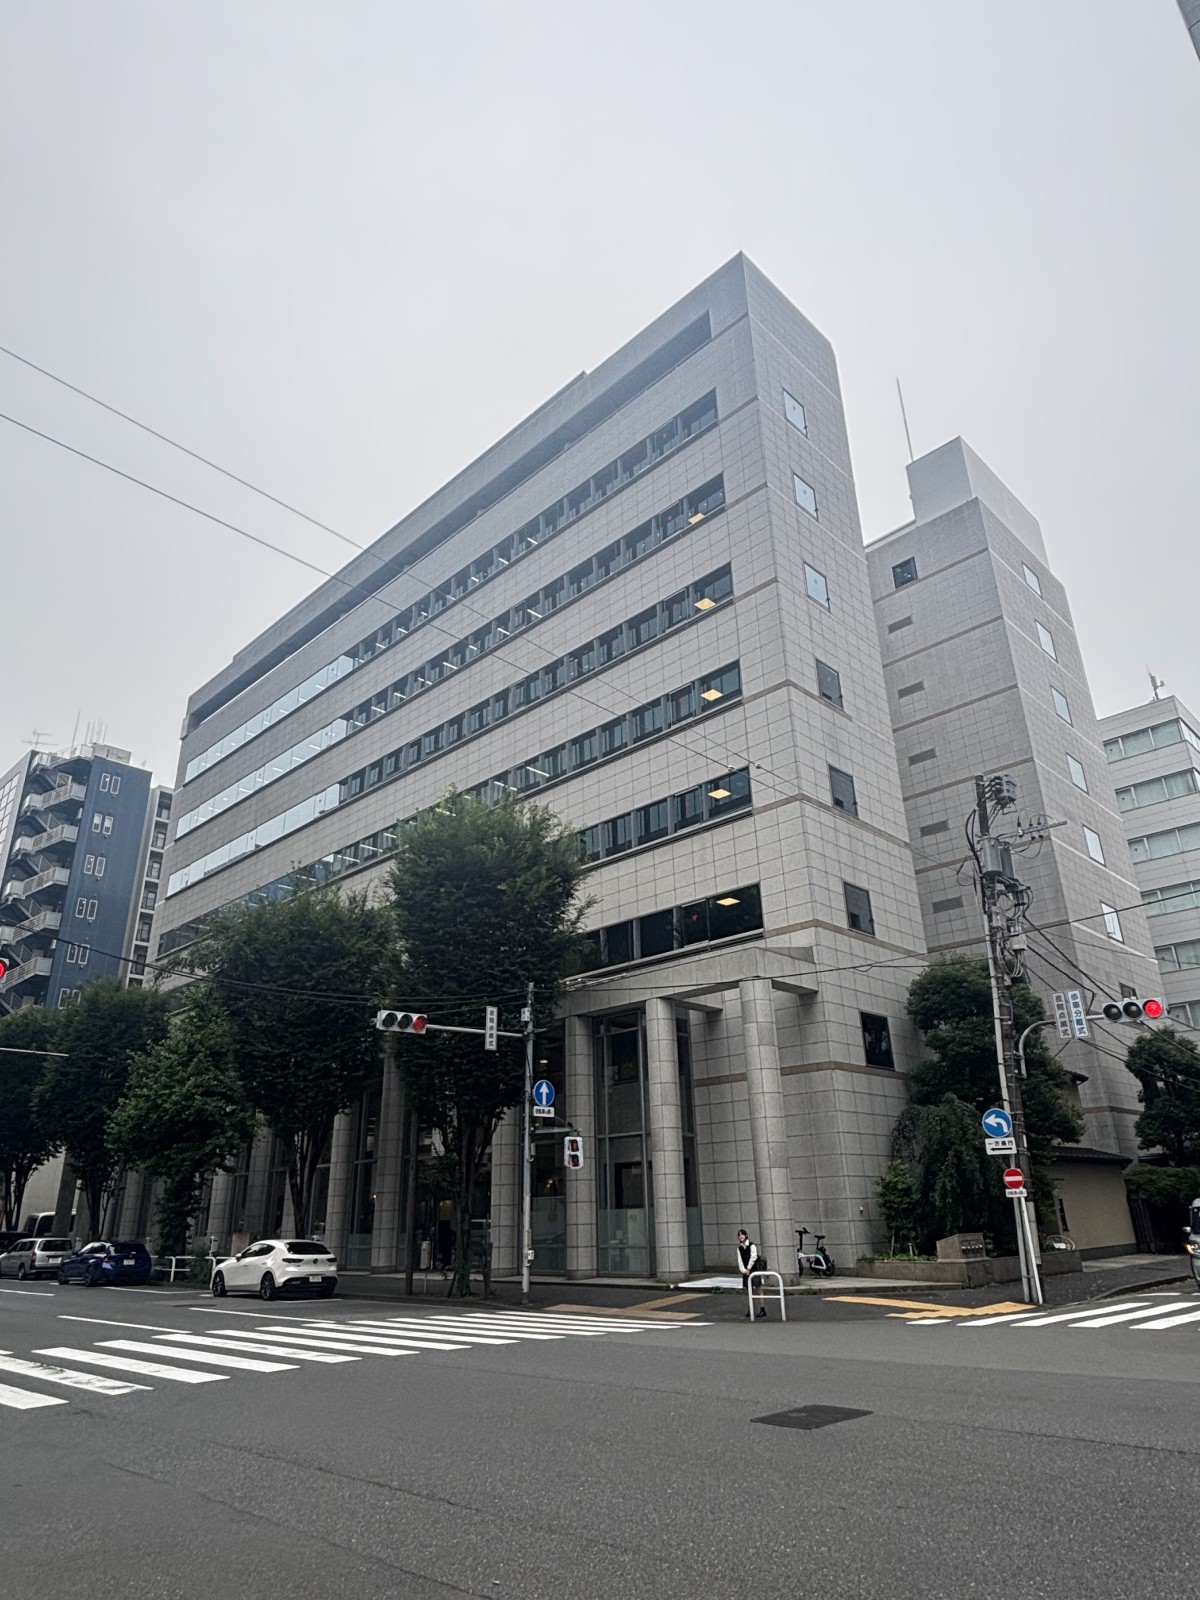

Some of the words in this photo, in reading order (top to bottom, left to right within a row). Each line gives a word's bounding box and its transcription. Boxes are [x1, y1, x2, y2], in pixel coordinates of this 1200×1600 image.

[1070, 993, 1087, 1035] 歩車分離式
